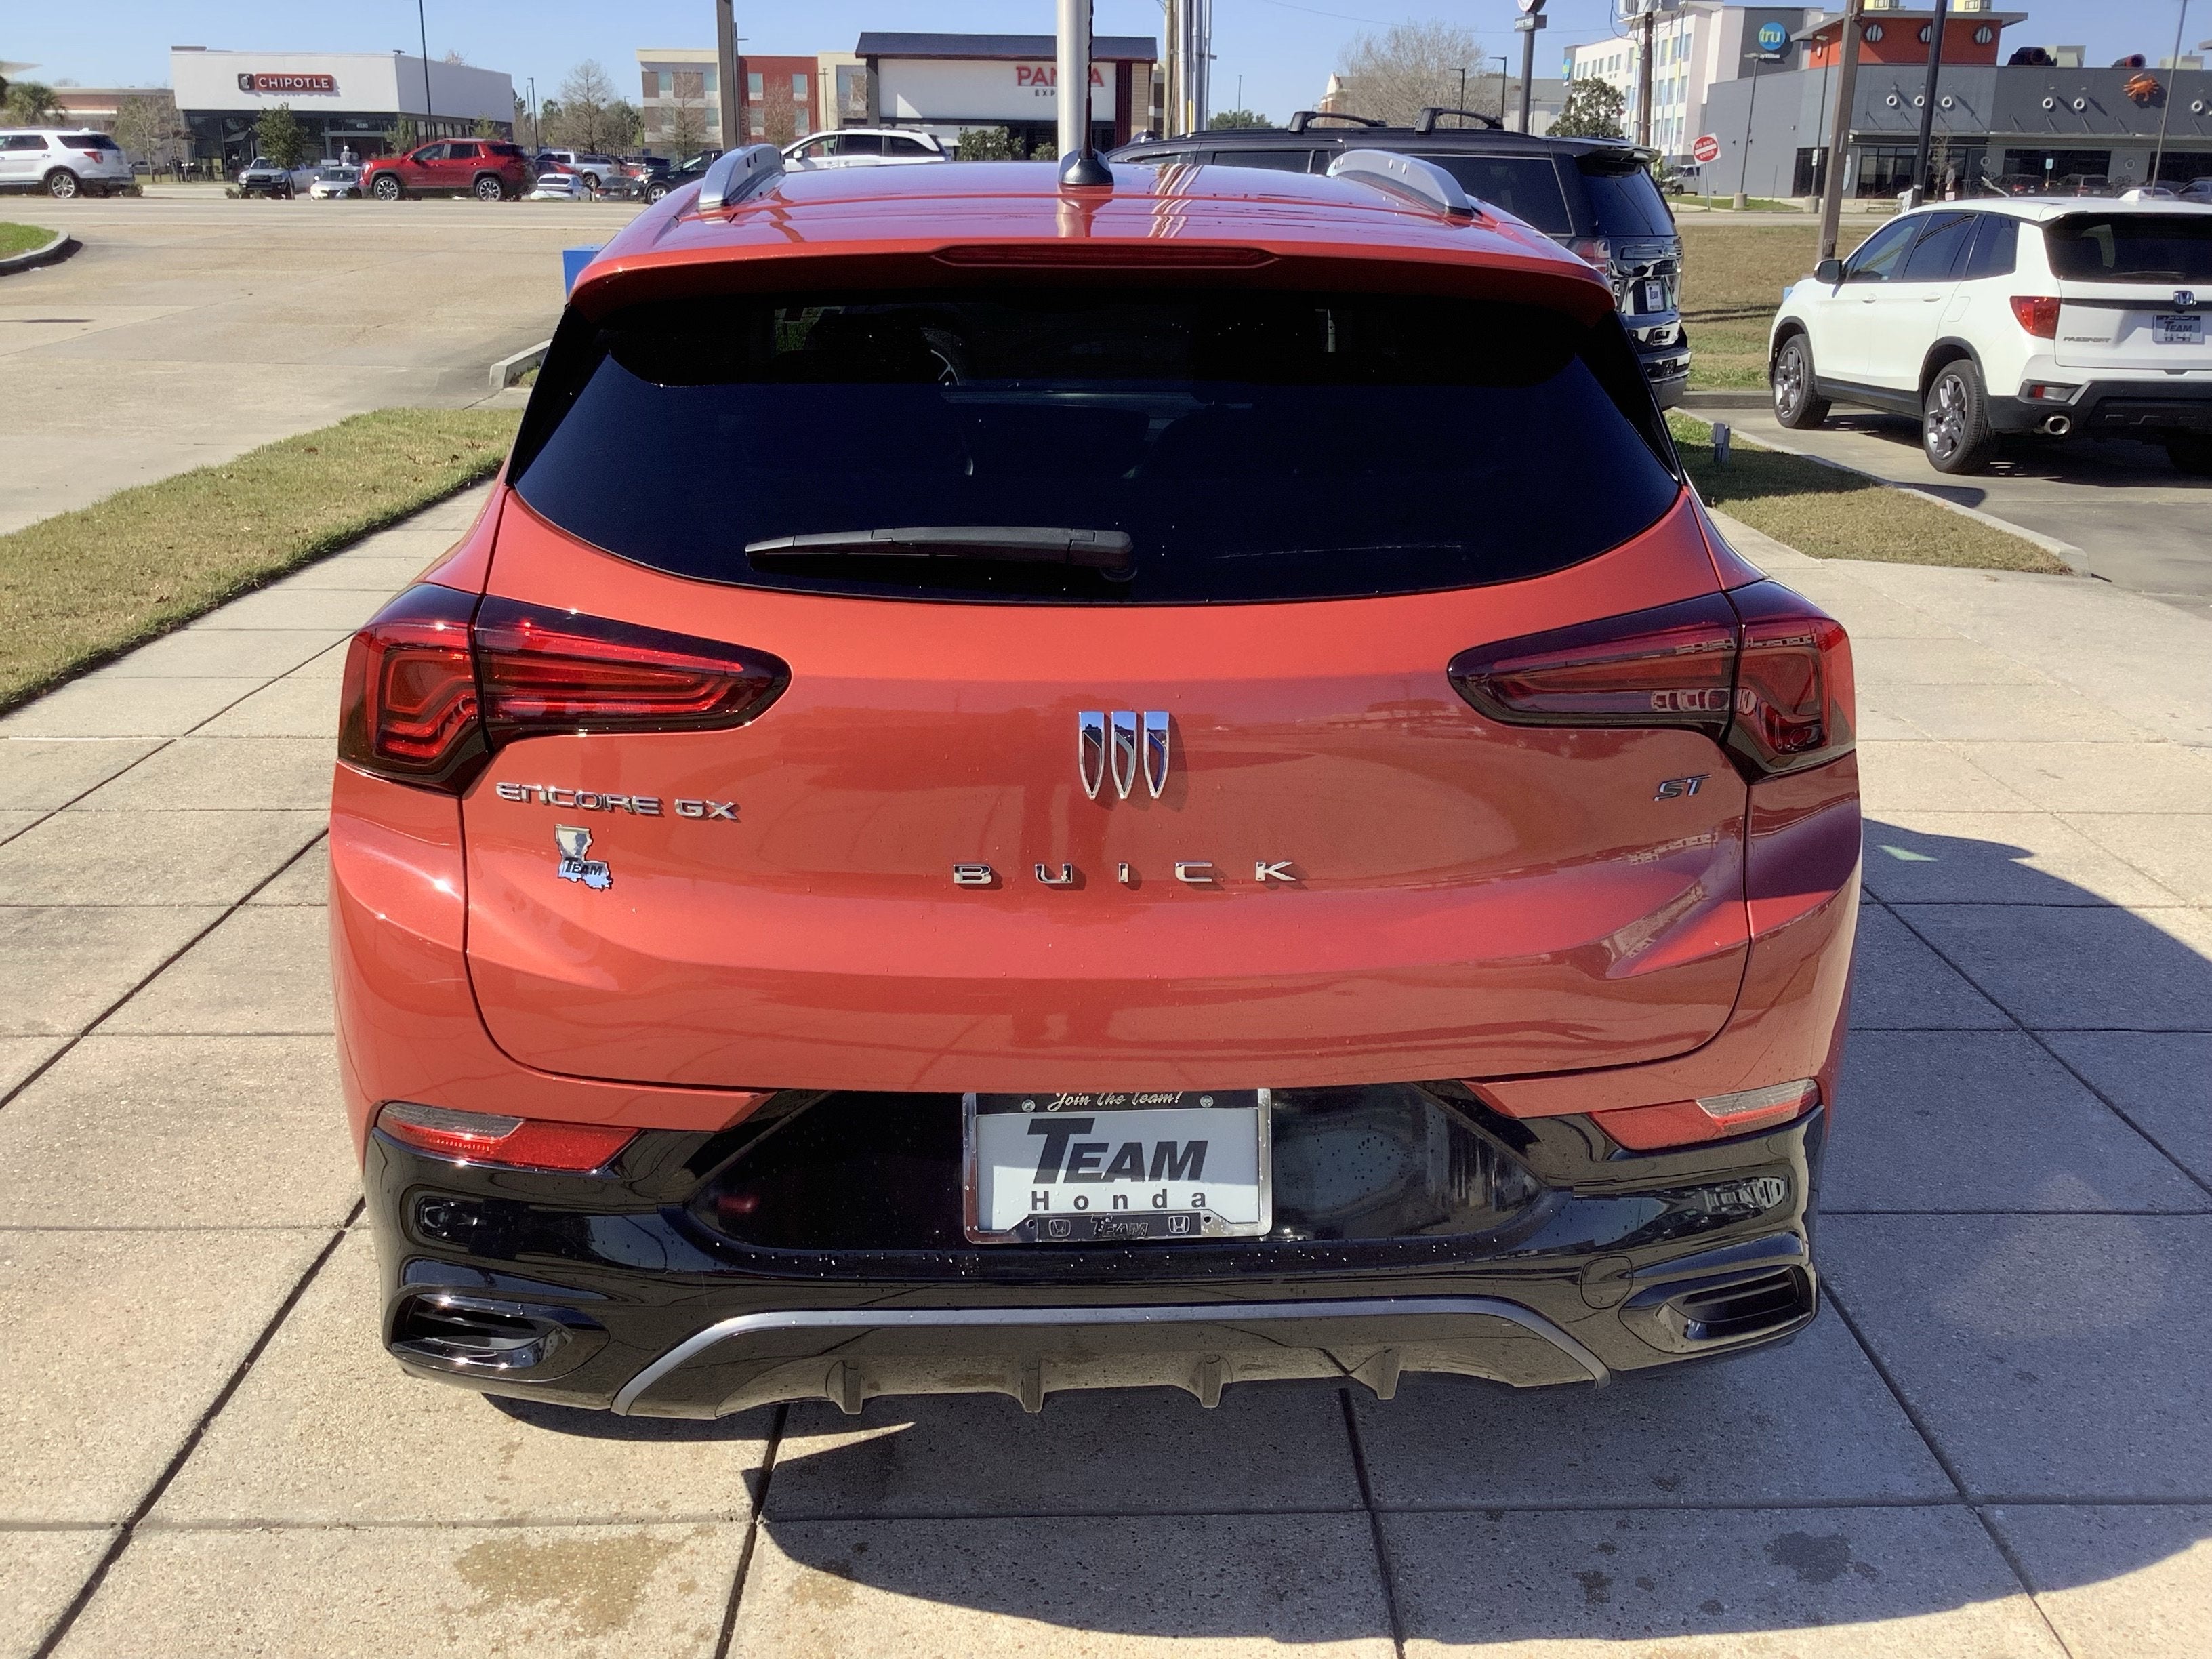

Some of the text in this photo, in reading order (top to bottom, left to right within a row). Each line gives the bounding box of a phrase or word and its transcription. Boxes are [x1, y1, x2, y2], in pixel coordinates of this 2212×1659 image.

[1759, 28, 1780, 43] tru
[258, 77, 329, 88] CHIPOTLE
[1016, 66, 1104, 87] PAA
[2164, 321, 2193, 332] TEAM
[1653, 773, 1712, 802] ST
[495, 781, 738, 820] ENCORE GX
[565, 856, 603, 876] TEAM
[953, 861, 1296, 884] BUICK
[1047, 1092, 1090, 1112] Join
[1027, 1117, 1209, 1185] TEAM
[1031, 1188, 1206, 1211] Honda
[1090, 1212, 1149, 1237] TEAM
